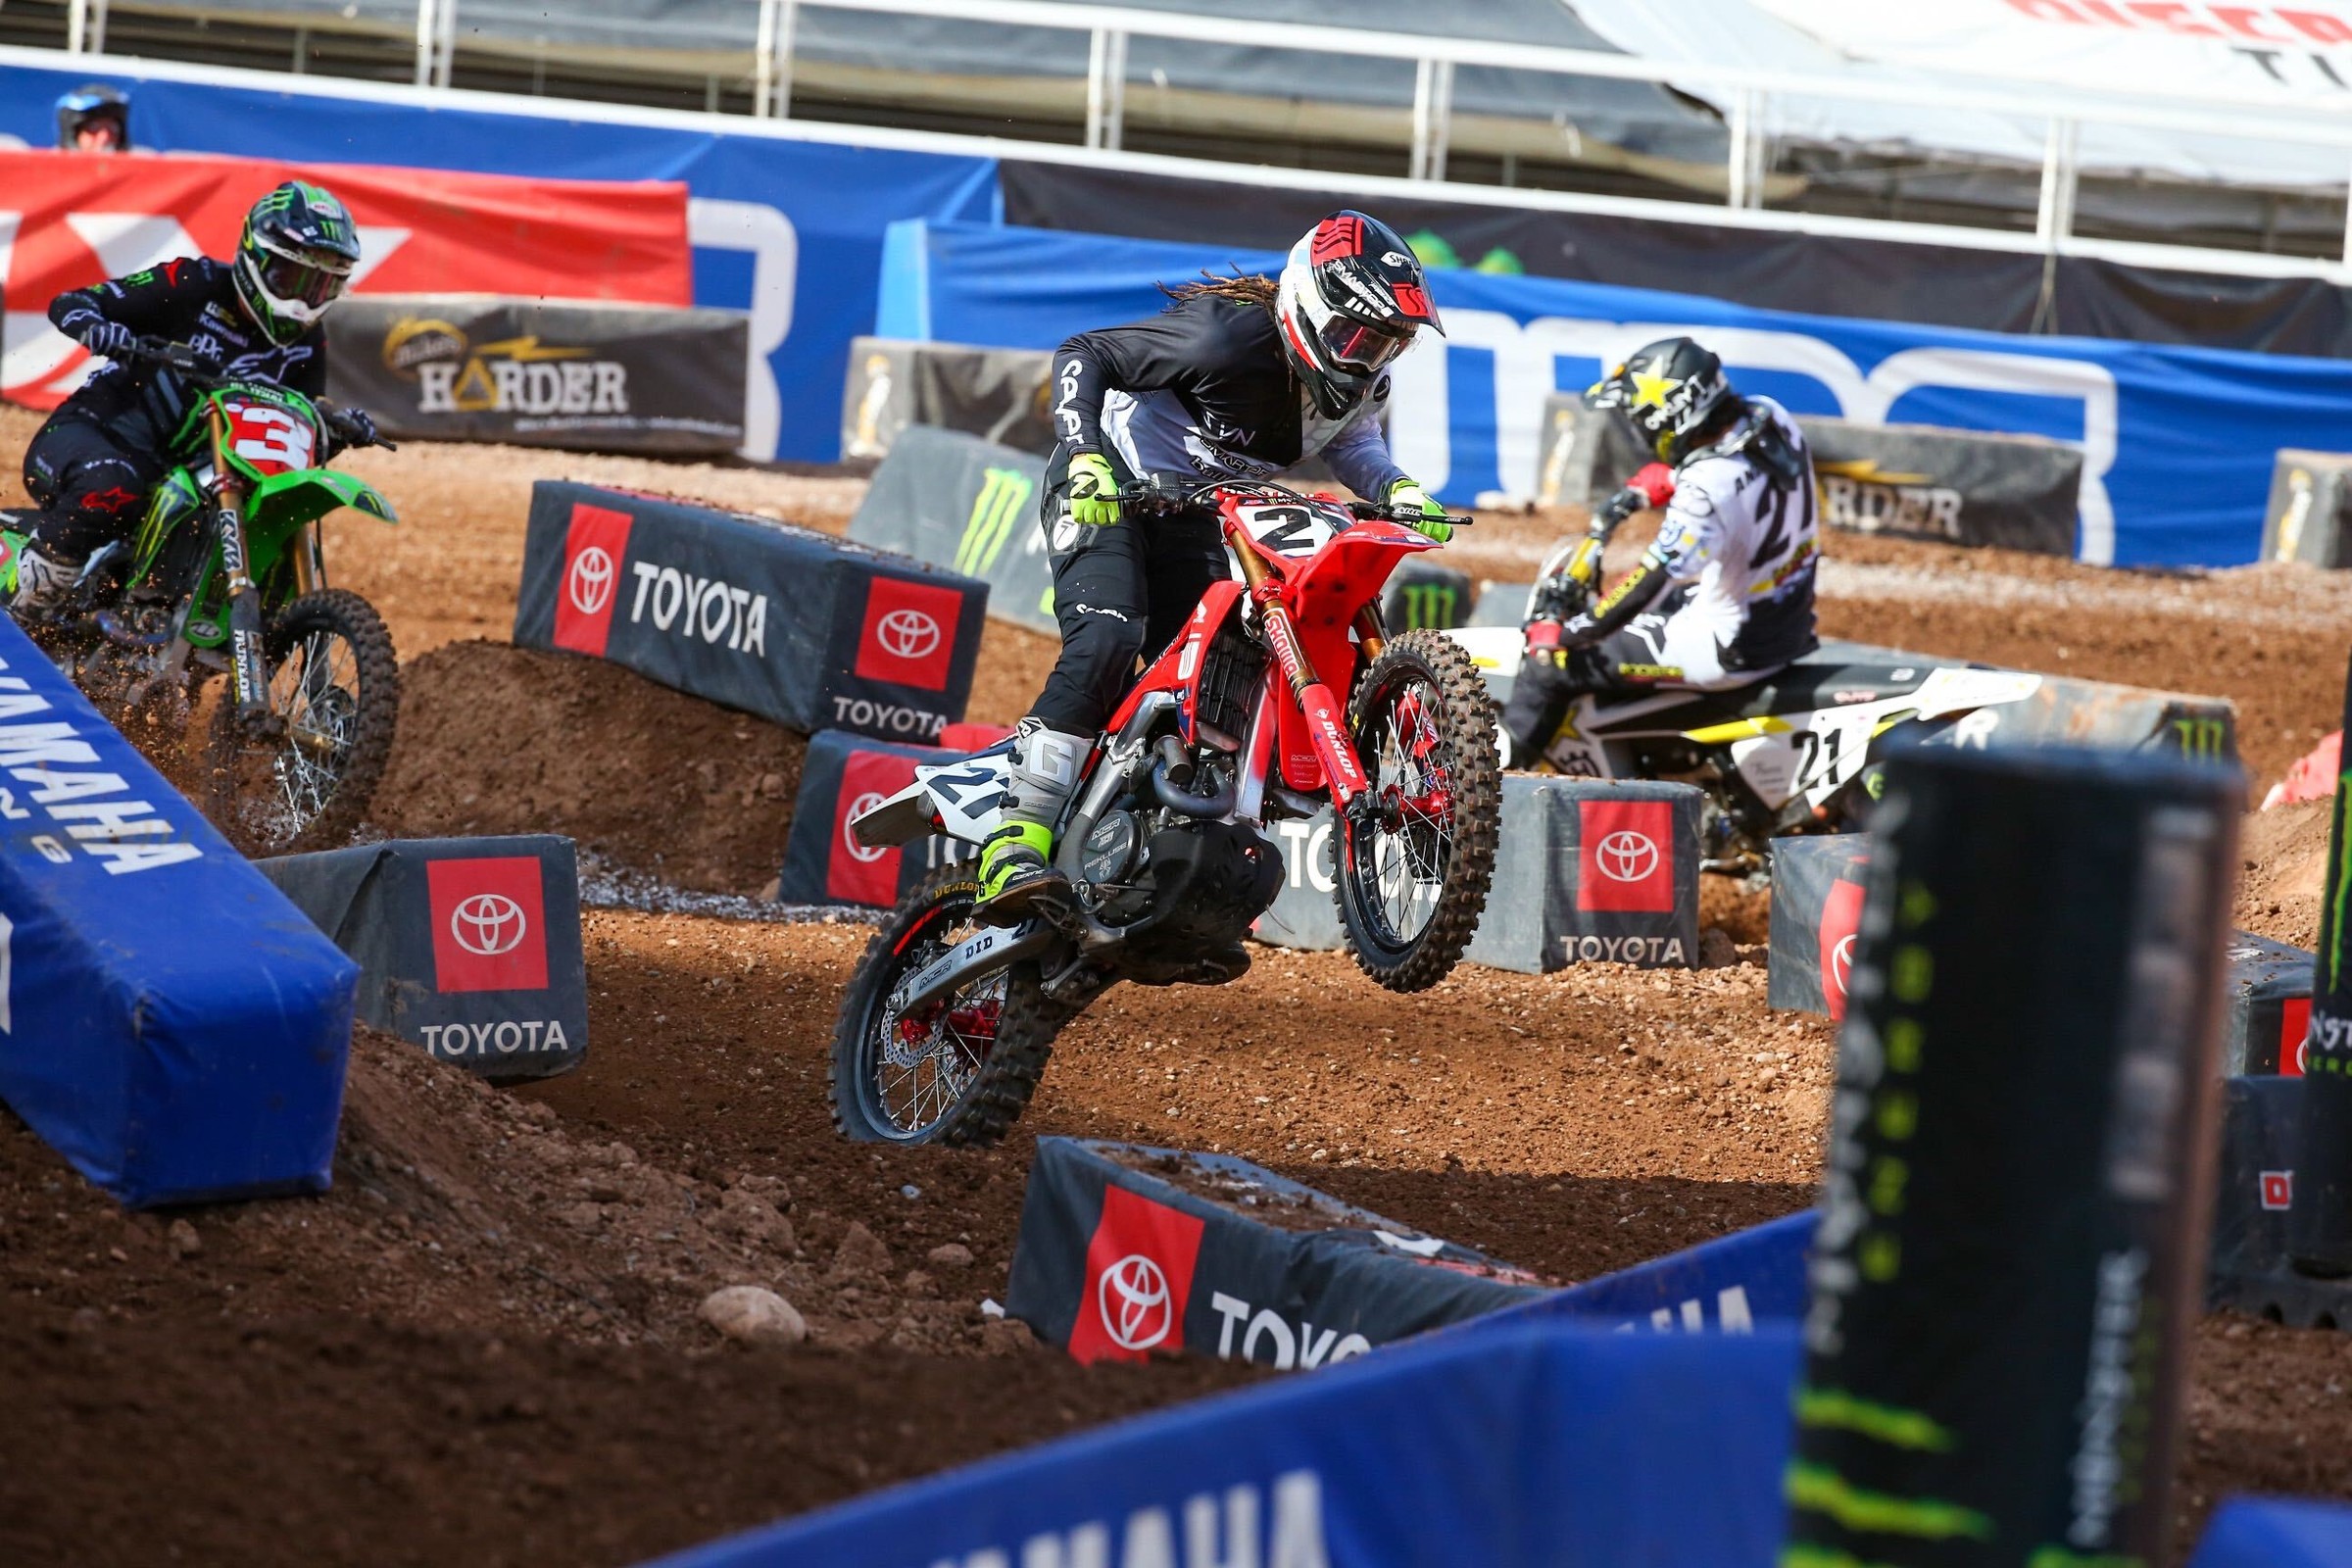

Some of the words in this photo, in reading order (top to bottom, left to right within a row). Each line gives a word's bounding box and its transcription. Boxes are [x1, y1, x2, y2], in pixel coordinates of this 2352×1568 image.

[416, 361, 629, 415] HARDER
[234, 407, 313, 471] 3
[1823, 473, 1963, 542] RDER
[631, 561, 768, 658] TOYOTA
[833, 696, 951, 738] TOYOTA
[0, 655, 204, 876] AMAHA
[1322, 720, 1358, 780] DUNLOP
[1790, 728, 1843, 786] 21
[1084, 841, 1128, 871] REKLUSE
[1560, 934, 1687, 965] TOYOTA
[420, 1019, 568, 1055] TOYOTA
[1211, 1290, 1373, 1371] TOYO
